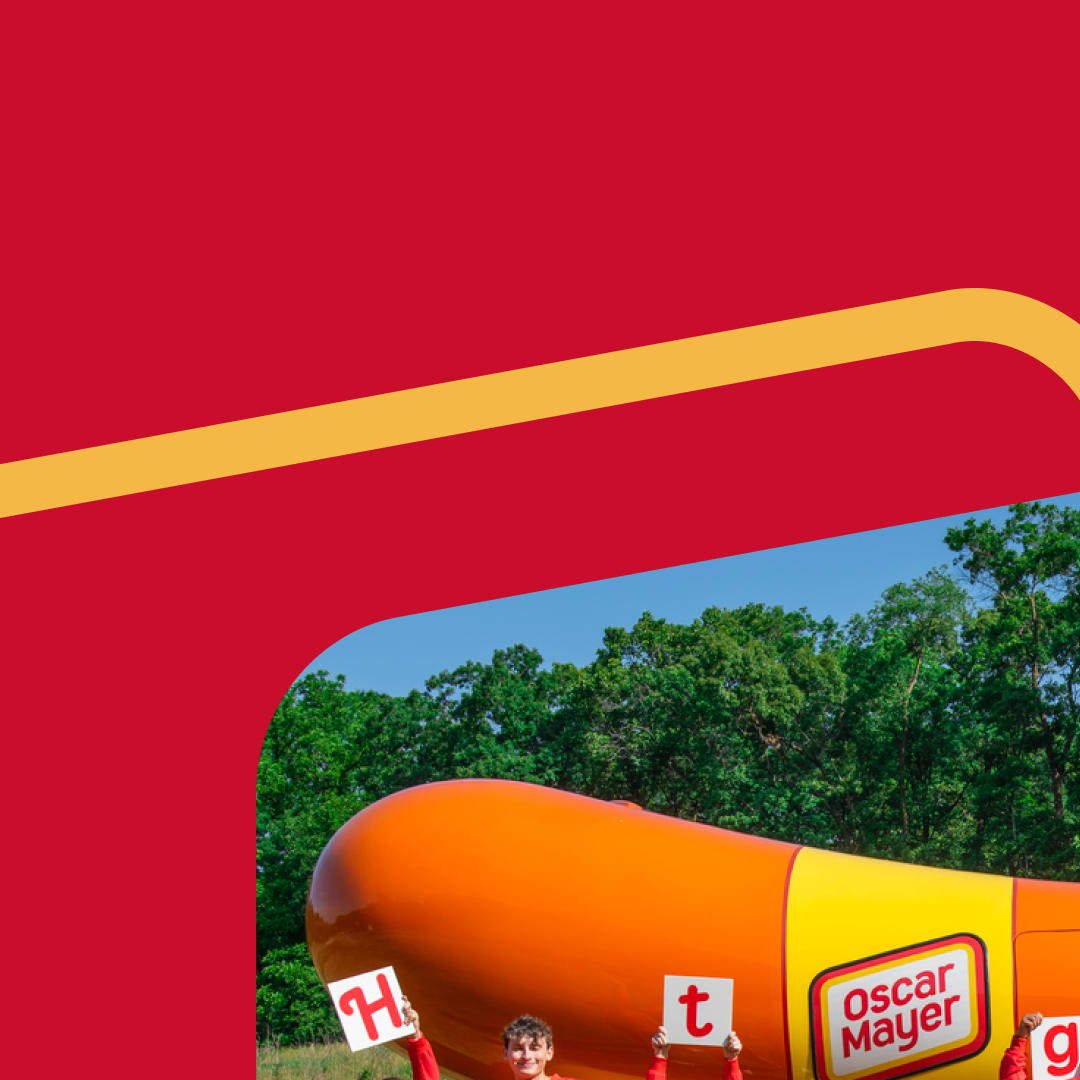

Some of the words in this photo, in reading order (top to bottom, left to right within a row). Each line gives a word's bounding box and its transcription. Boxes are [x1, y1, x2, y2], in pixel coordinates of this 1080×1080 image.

[339, 973, 403, 1042] H
[678, 984, 713, 1039] t
[843, 963, 955, 1022] Oscar
[841, 994, 961, 1059] Mayer
[1043, 1022, 1080, 1077] g
